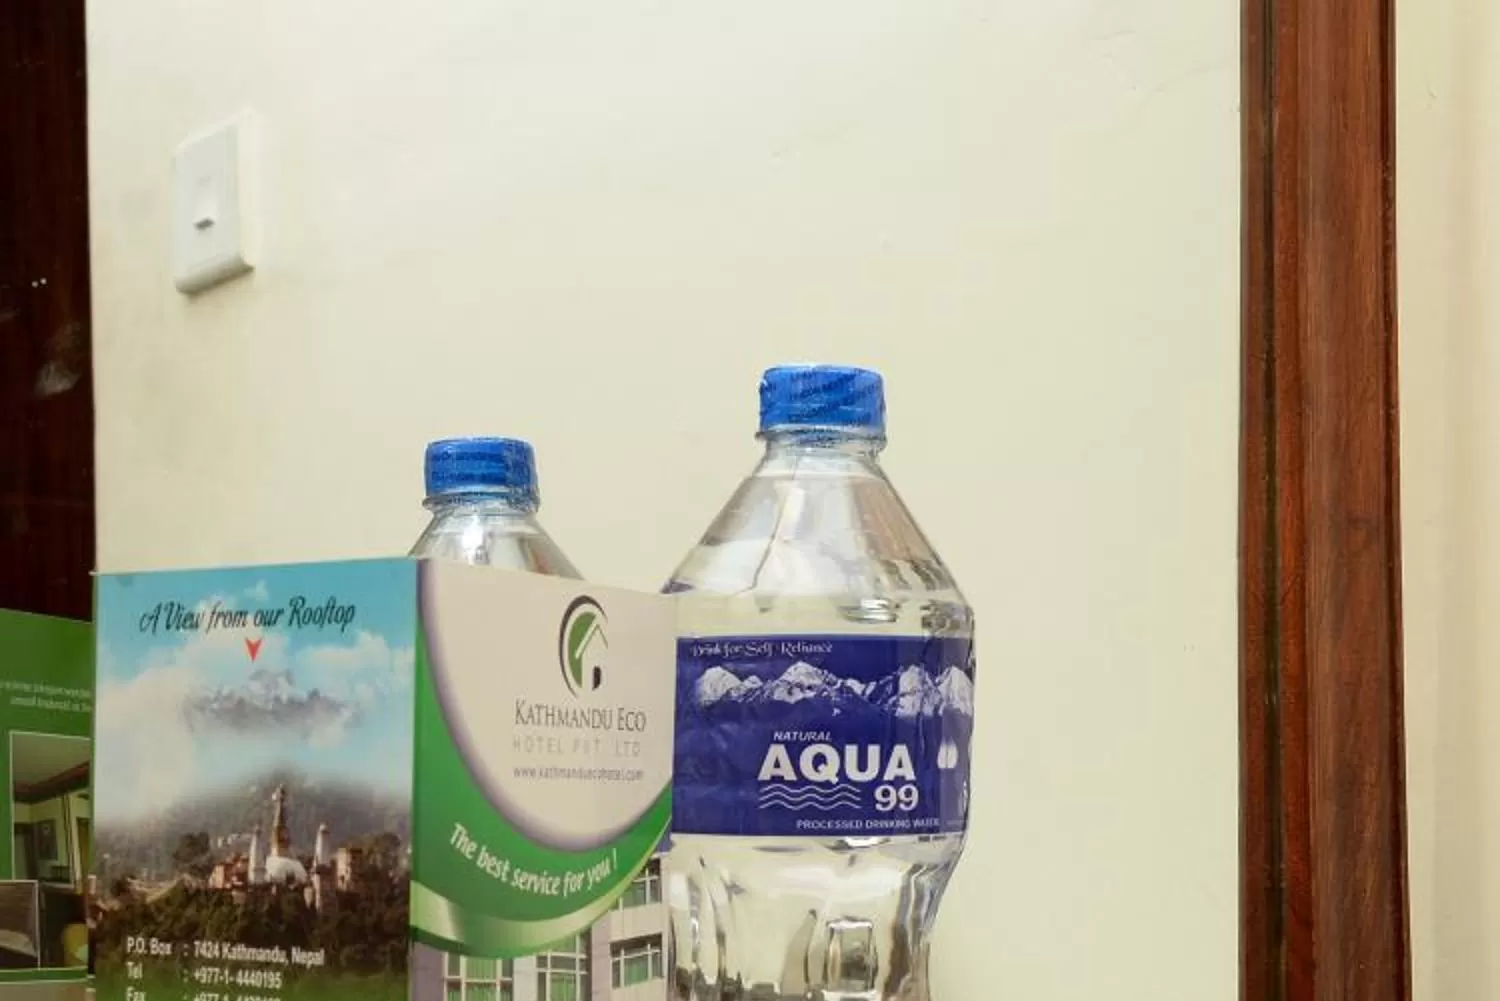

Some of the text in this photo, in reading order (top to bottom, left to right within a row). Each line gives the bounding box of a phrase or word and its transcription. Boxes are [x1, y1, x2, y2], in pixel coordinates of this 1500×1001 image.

[139, 595, 356, 635] A View from our Rooftop
[513, 736, 564, 753] HOTEL
[773, 731, 832, 741] NATURAL
[757, 743, 917, 784] AQUA
[874, 784, 919, 811] 99
[796, 819, 862, 829] PROCESSED
[865, 818, 911, 829] DRINKING
[450, 821, 477, 860] The
[476, 845, 511, 882] best
[511, 867, 561, 896] service
[563, 870, 585, 899] for
[127, 937, 147, 955] P.O.
[150, 938, 172, 955] Box
[193, 941, 220, 959] 7424
[222, 942, 289, 965] Kathmandu,
[291, 949, 325, 969] Nepal
[126, 961, 143, 979] Tel
